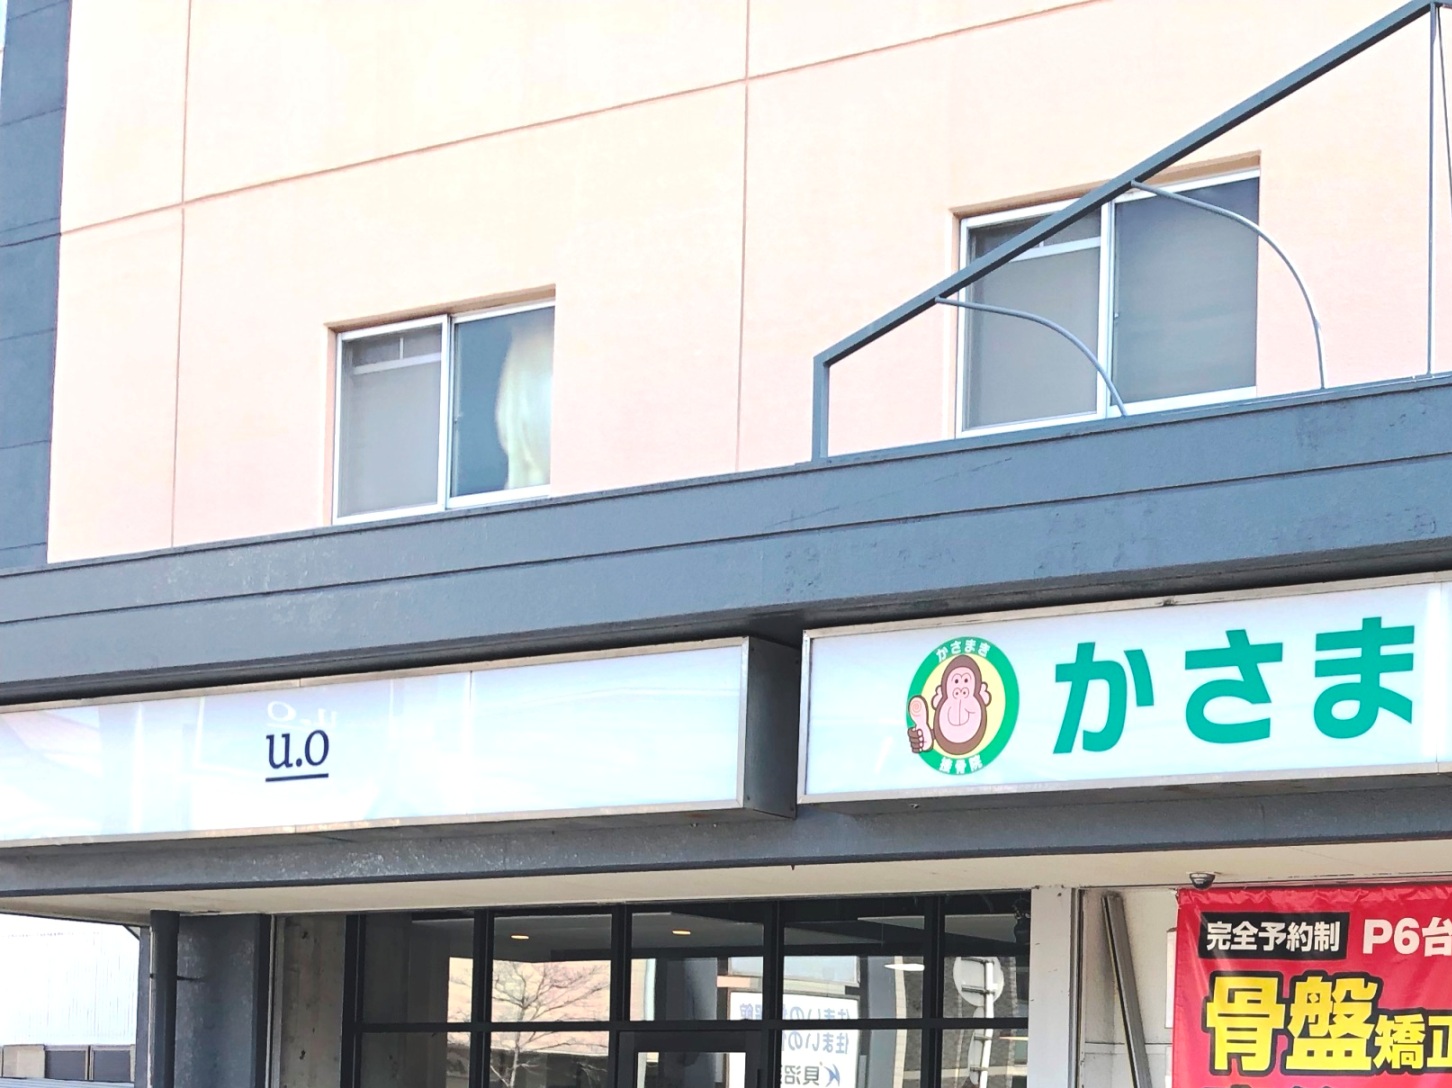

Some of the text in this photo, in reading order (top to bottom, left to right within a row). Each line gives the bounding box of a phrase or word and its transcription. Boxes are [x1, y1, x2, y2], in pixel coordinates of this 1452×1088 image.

[936, 639, 990, 661] かさまき
[1207, 920, 1340, 952] 完全予約制
